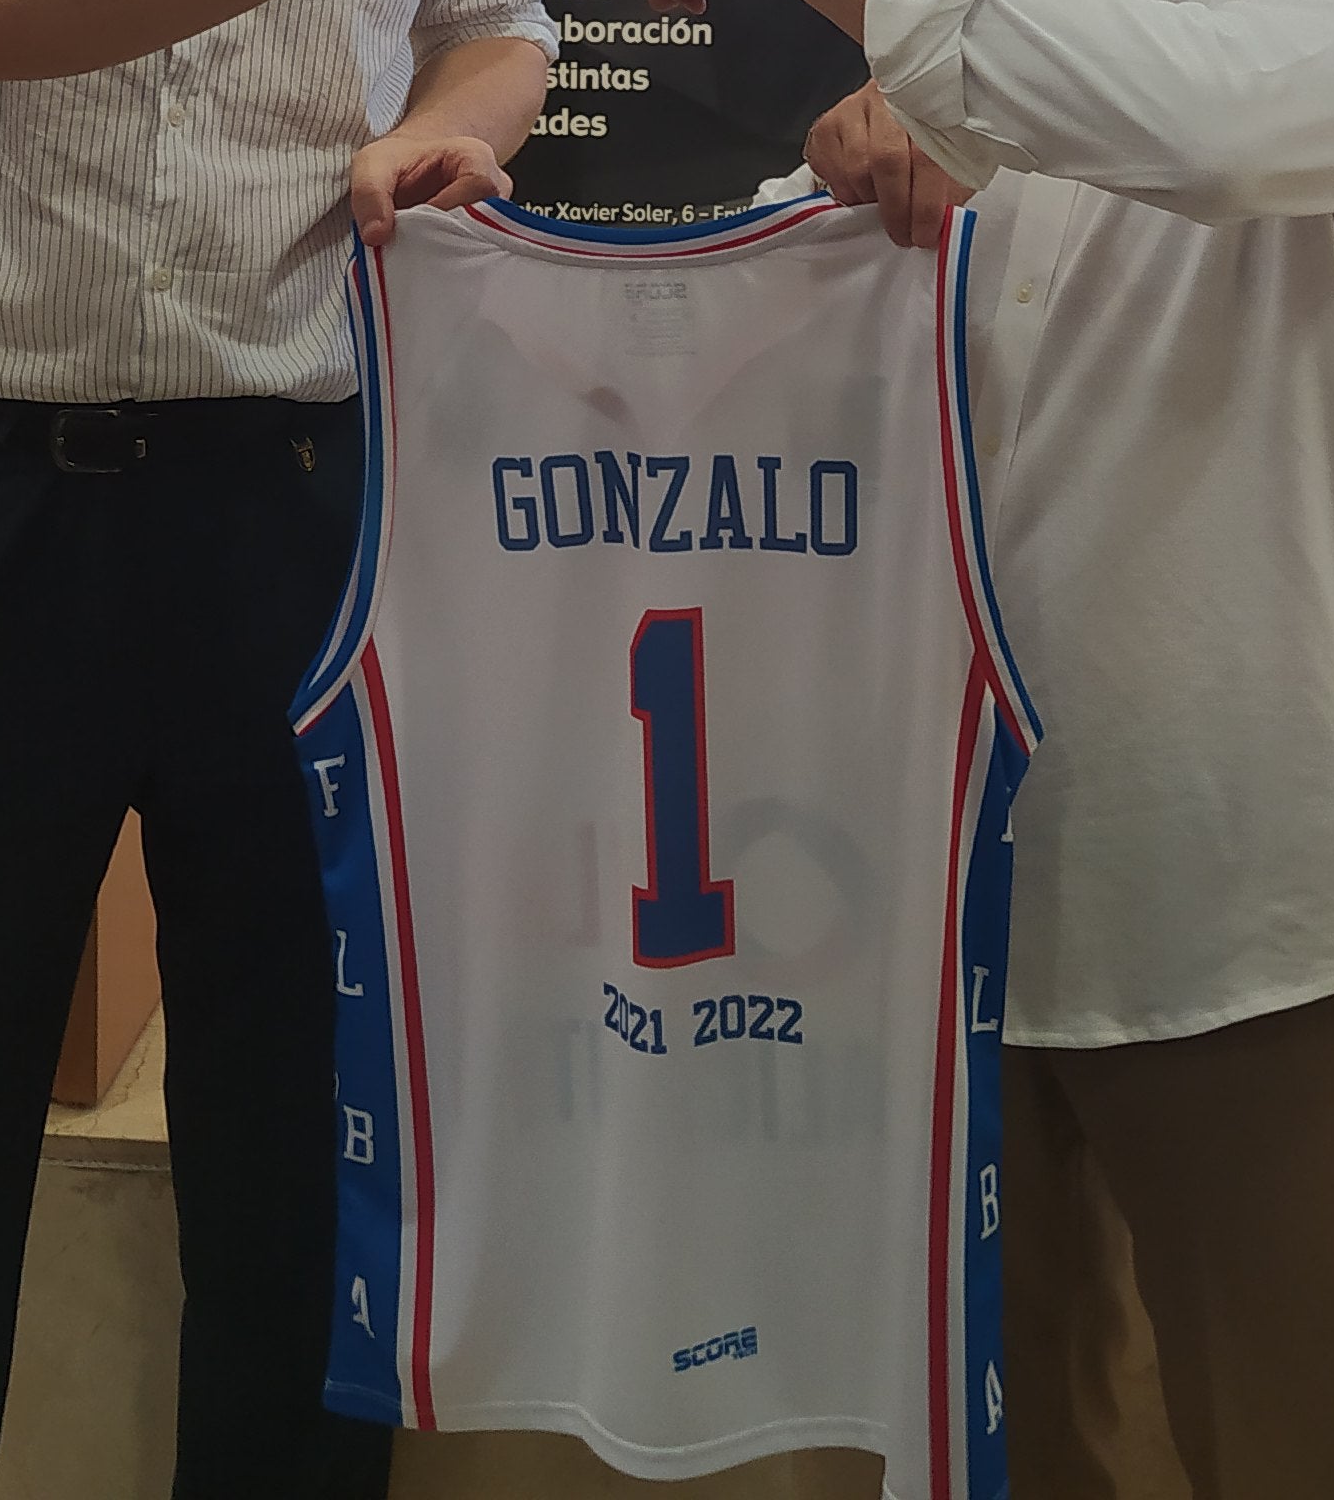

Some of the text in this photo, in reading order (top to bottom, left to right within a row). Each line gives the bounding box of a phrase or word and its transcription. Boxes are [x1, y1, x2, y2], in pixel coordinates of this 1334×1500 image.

[556, 200, 619, 222] Xavier
[621, 202, 679, 227] Soler,
[681, 204, 695, 223] 6
[491, 449, 859, 557] GONZALO
[629, 606, 736, 970] 1
[602, 980, 804, 1056] 2021 2022
[671, 1325, 759, 1373] SCORE
